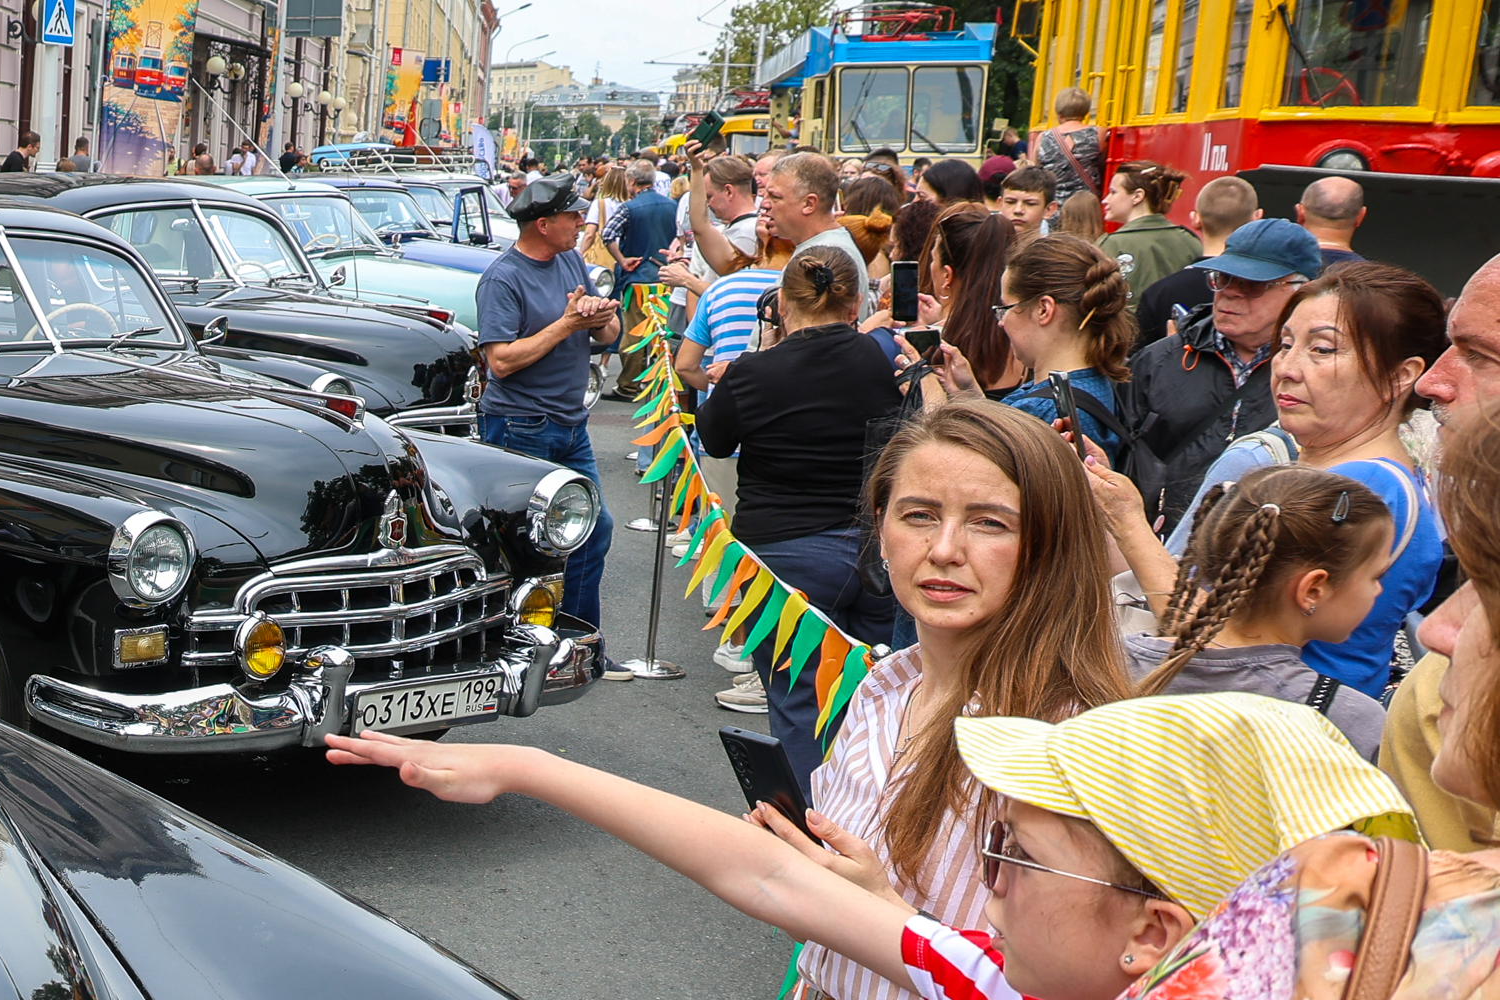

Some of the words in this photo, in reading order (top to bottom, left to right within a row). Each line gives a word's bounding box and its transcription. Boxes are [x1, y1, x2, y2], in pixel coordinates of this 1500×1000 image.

[362, 690, 456, 727] О313ХЕ
[462, 678, 496, 704] 199
[464, 703, 483, 713] RUS
